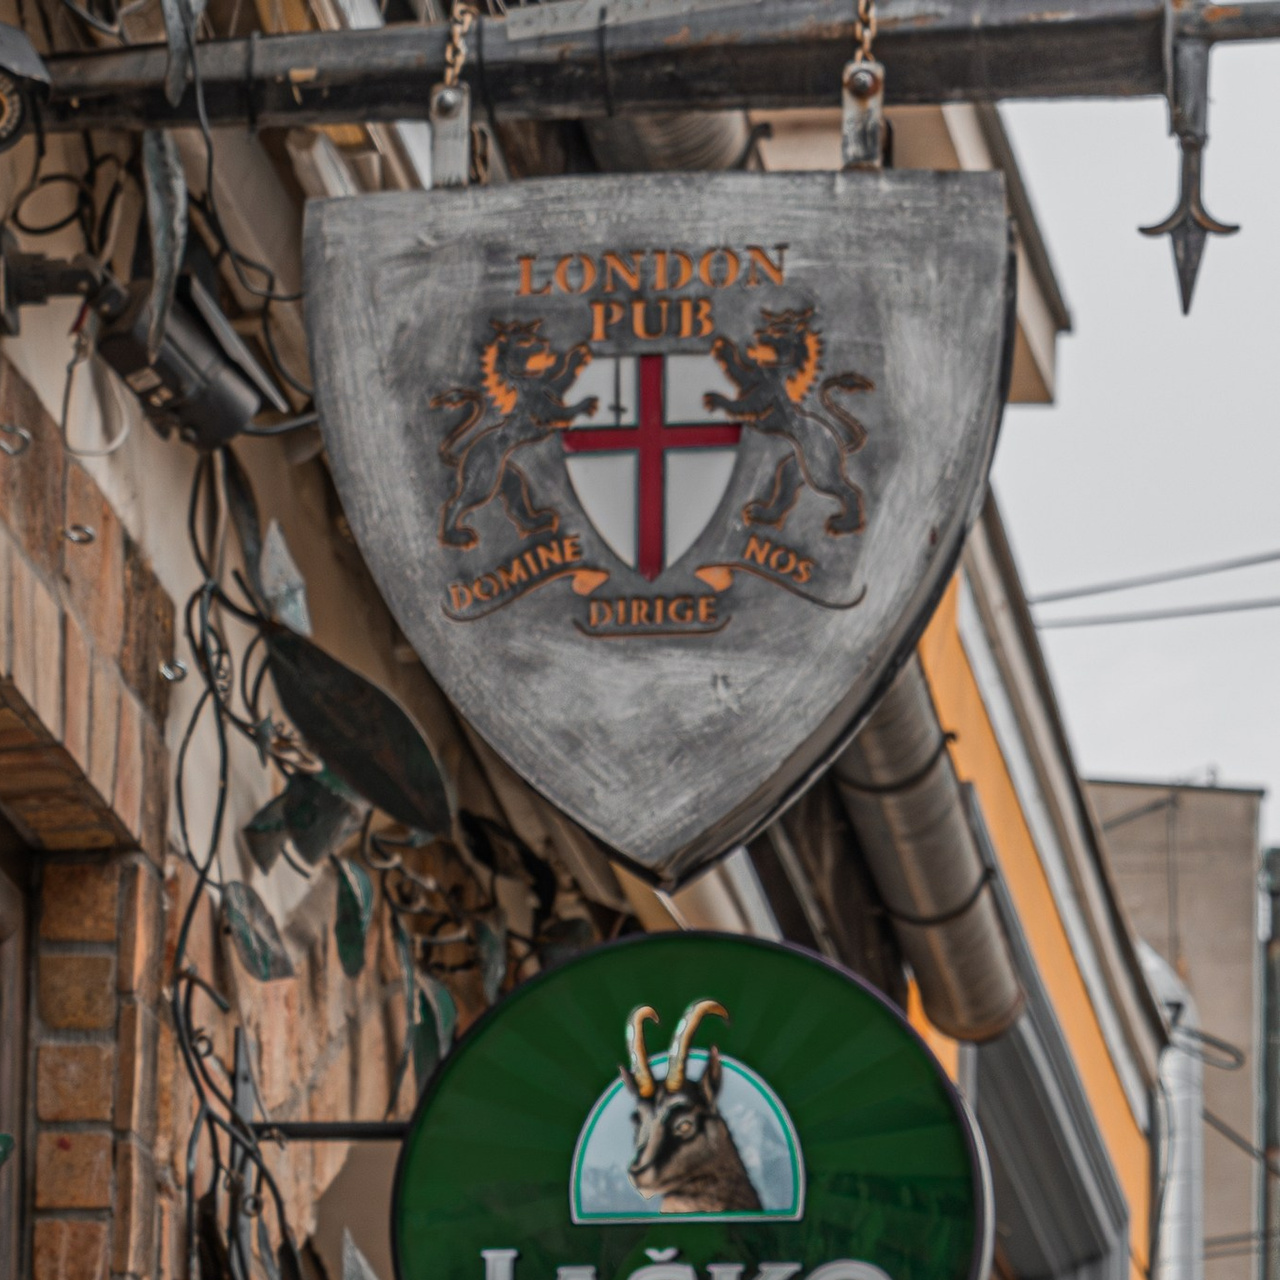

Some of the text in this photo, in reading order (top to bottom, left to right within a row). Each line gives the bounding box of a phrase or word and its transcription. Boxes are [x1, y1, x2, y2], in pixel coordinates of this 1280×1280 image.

[517, 244, 788, 297] LONDON
[590, 298, 716, 343] PUB
[449, 536, 815, 627] DOMINE DIRIGE NOS
